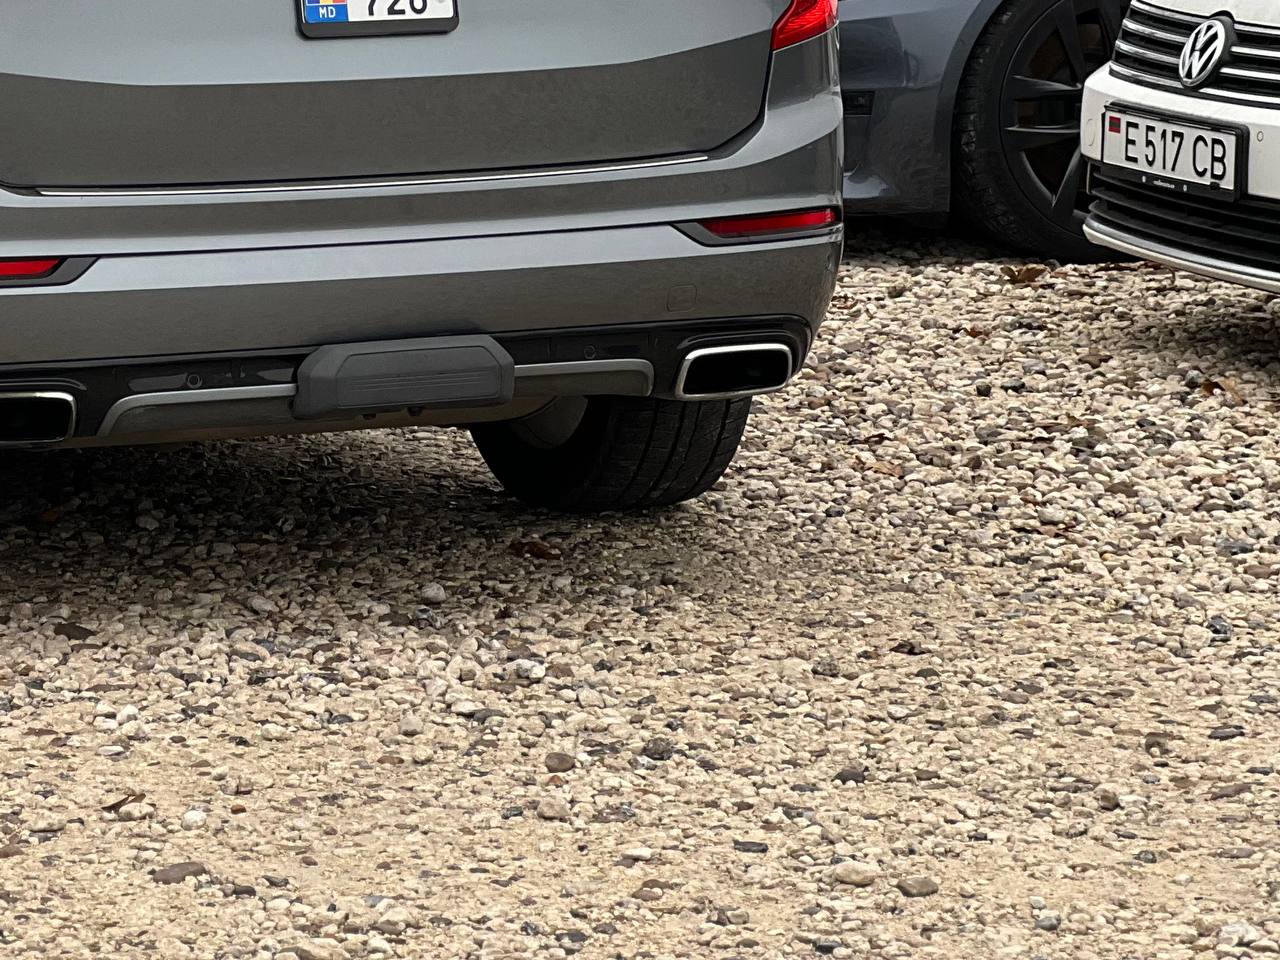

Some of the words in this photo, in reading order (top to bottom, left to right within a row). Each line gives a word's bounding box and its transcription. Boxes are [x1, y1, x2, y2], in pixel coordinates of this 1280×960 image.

[319, 5, 337, 20] MD
[1125, 121, 1139, 164] E
[1145, 125, 1185, 172] 517
[1192, 135, 1227, 181] CB
